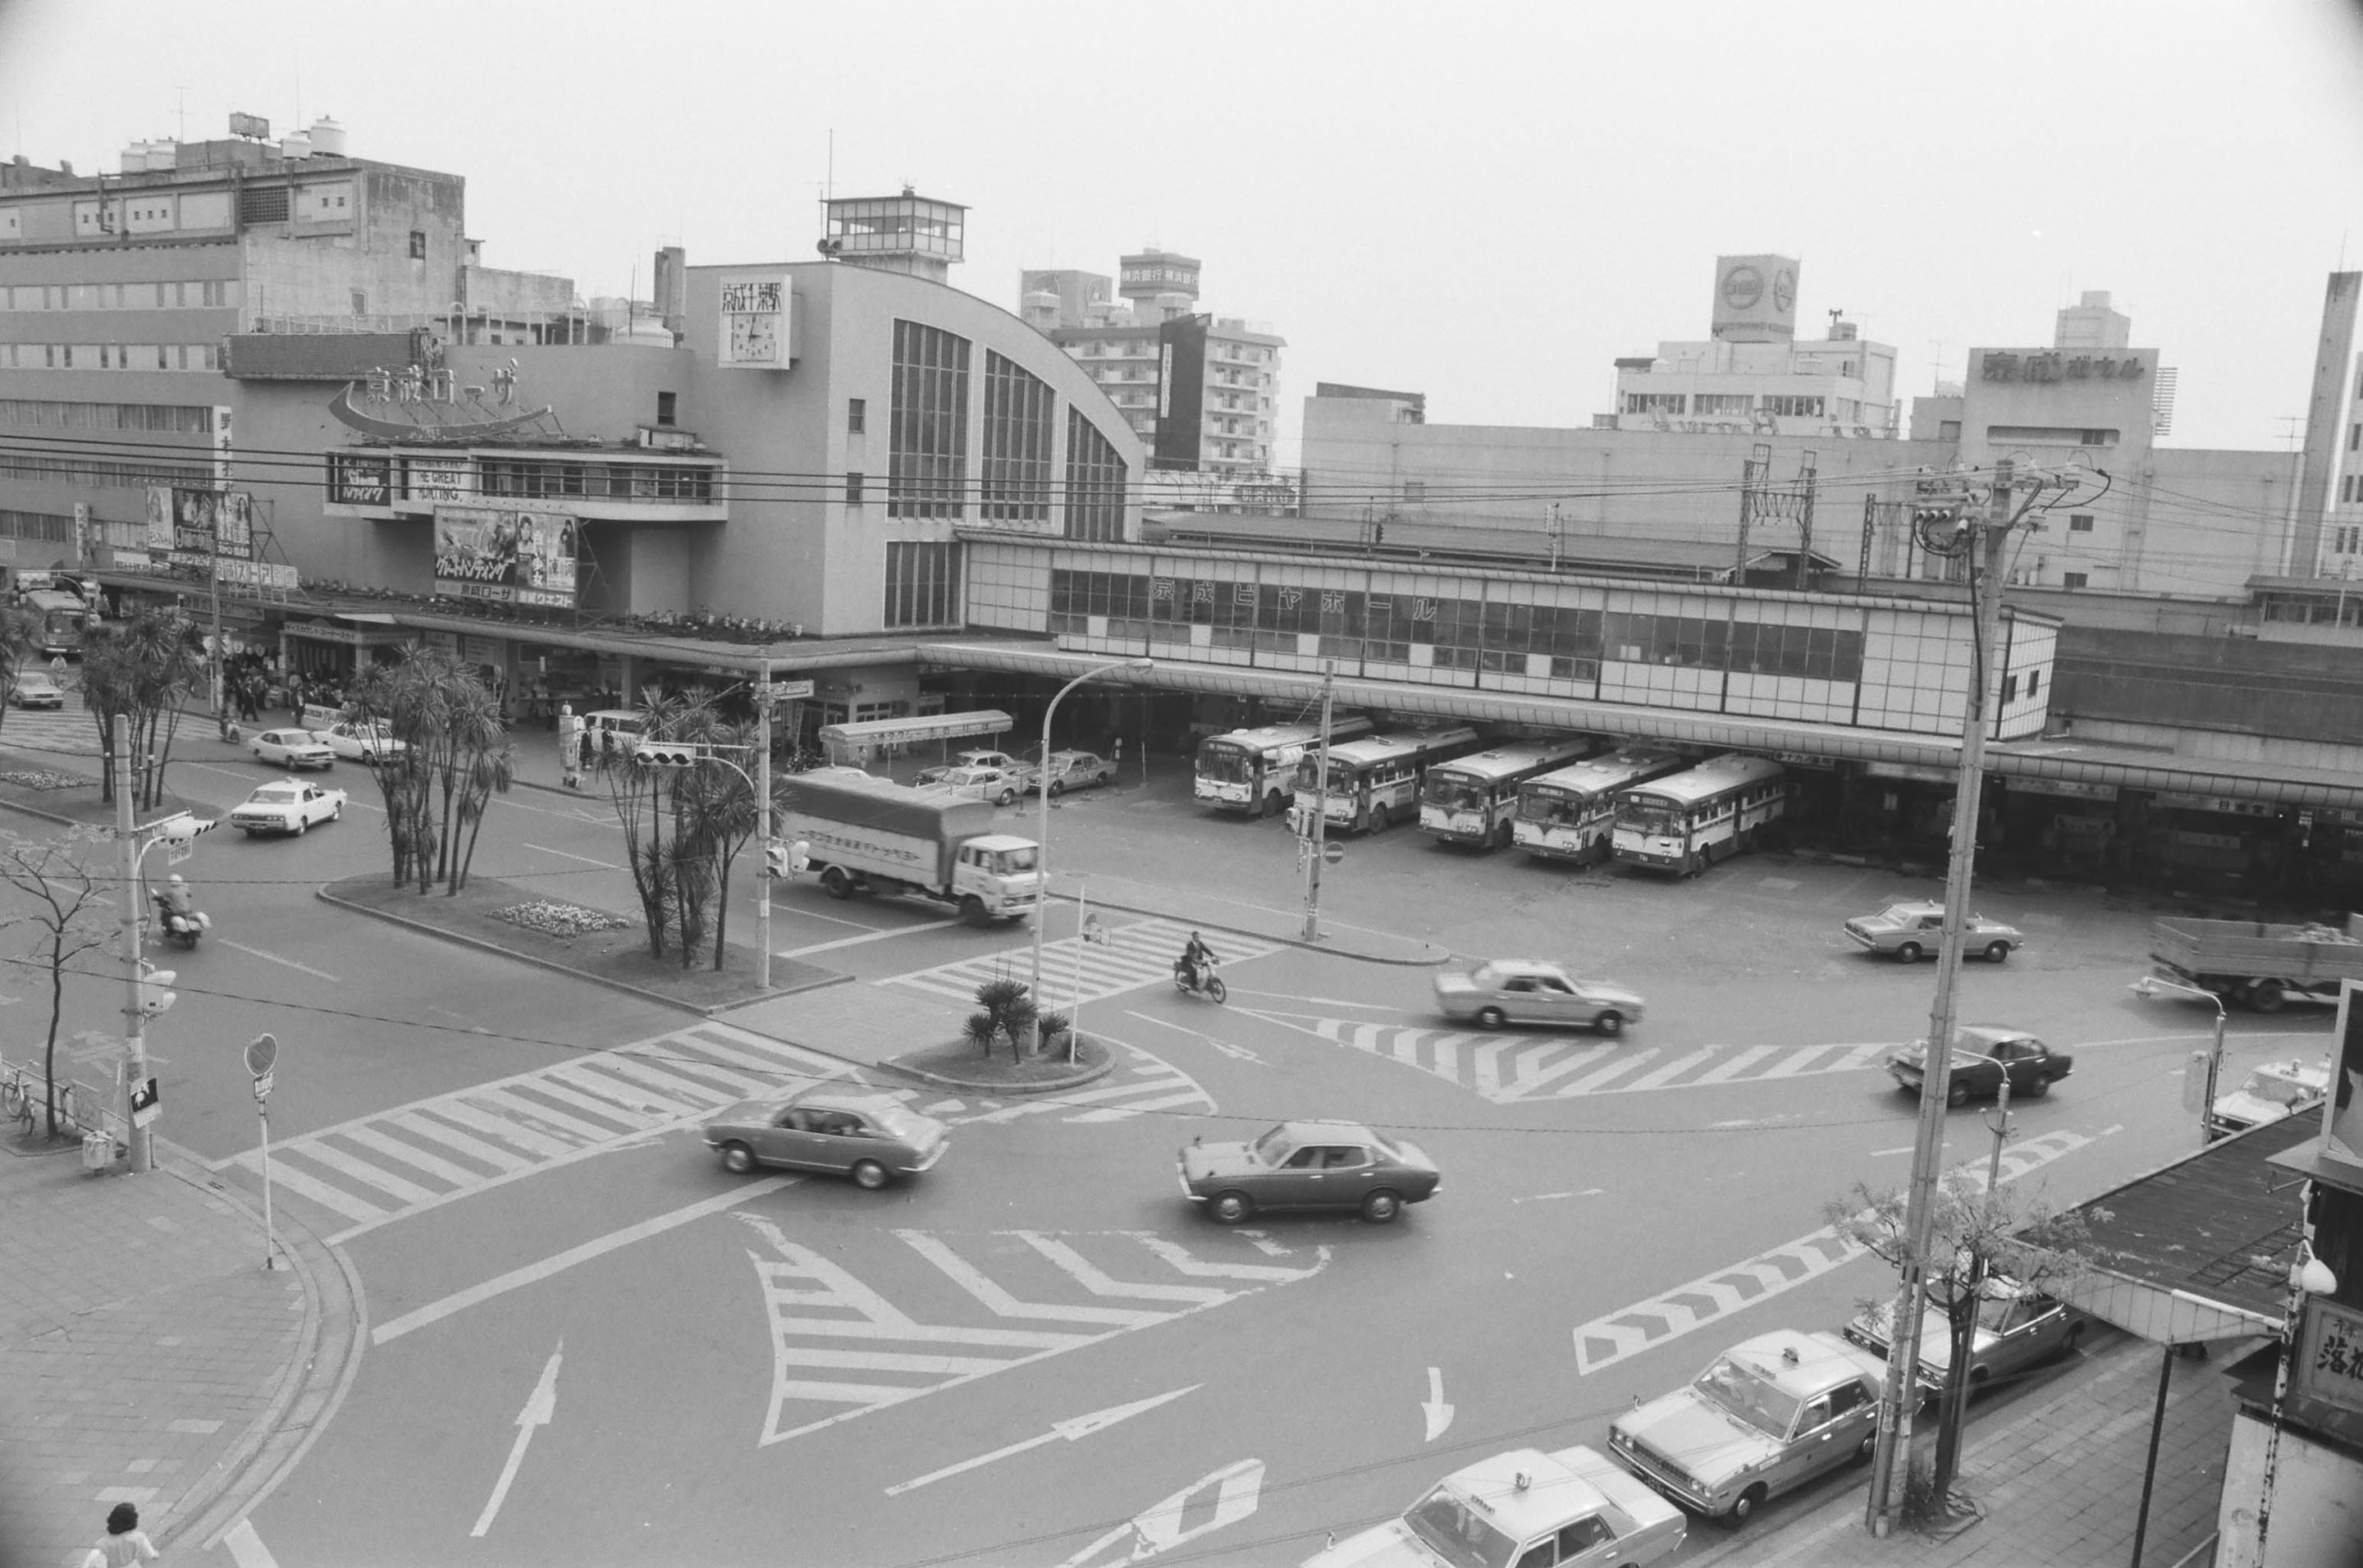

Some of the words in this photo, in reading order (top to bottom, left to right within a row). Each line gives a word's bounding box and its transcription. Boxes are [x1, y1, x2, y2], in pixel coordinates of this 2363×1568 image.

[1122, 269, 1162, 282] 横浜銀行
[367, 358, 520, 408] 京成ローザ
[432, 473, 461, 485] GREAT
[1153, 577, 1436, 621] 京成ビヤホール
